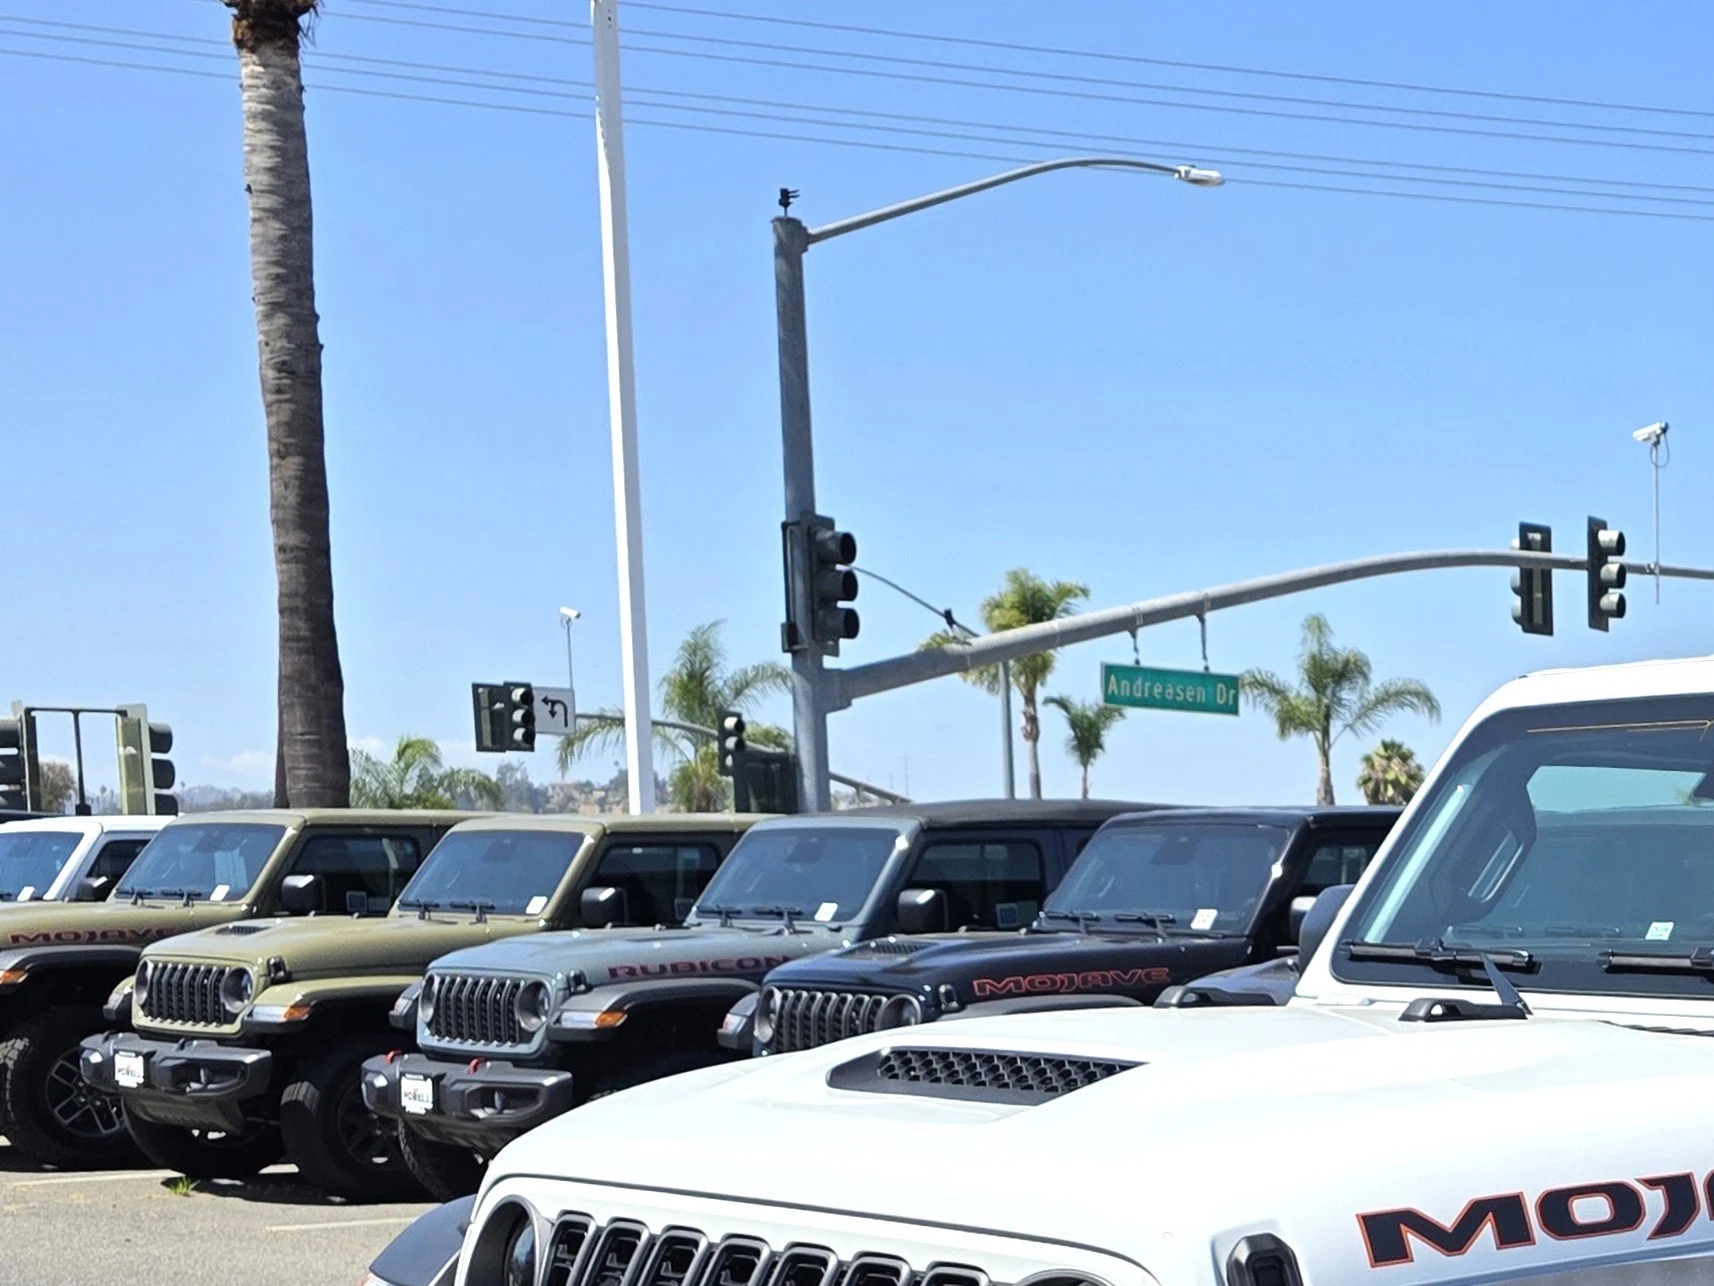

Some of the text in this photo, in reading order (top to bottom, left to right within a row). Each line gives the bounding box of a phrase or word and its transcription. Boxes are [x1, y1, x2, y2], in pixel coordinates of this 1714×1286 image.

[1107, 674, 1236, 705] Andreasen Dr
[972, 967, 1171, 996] MOJAVE
